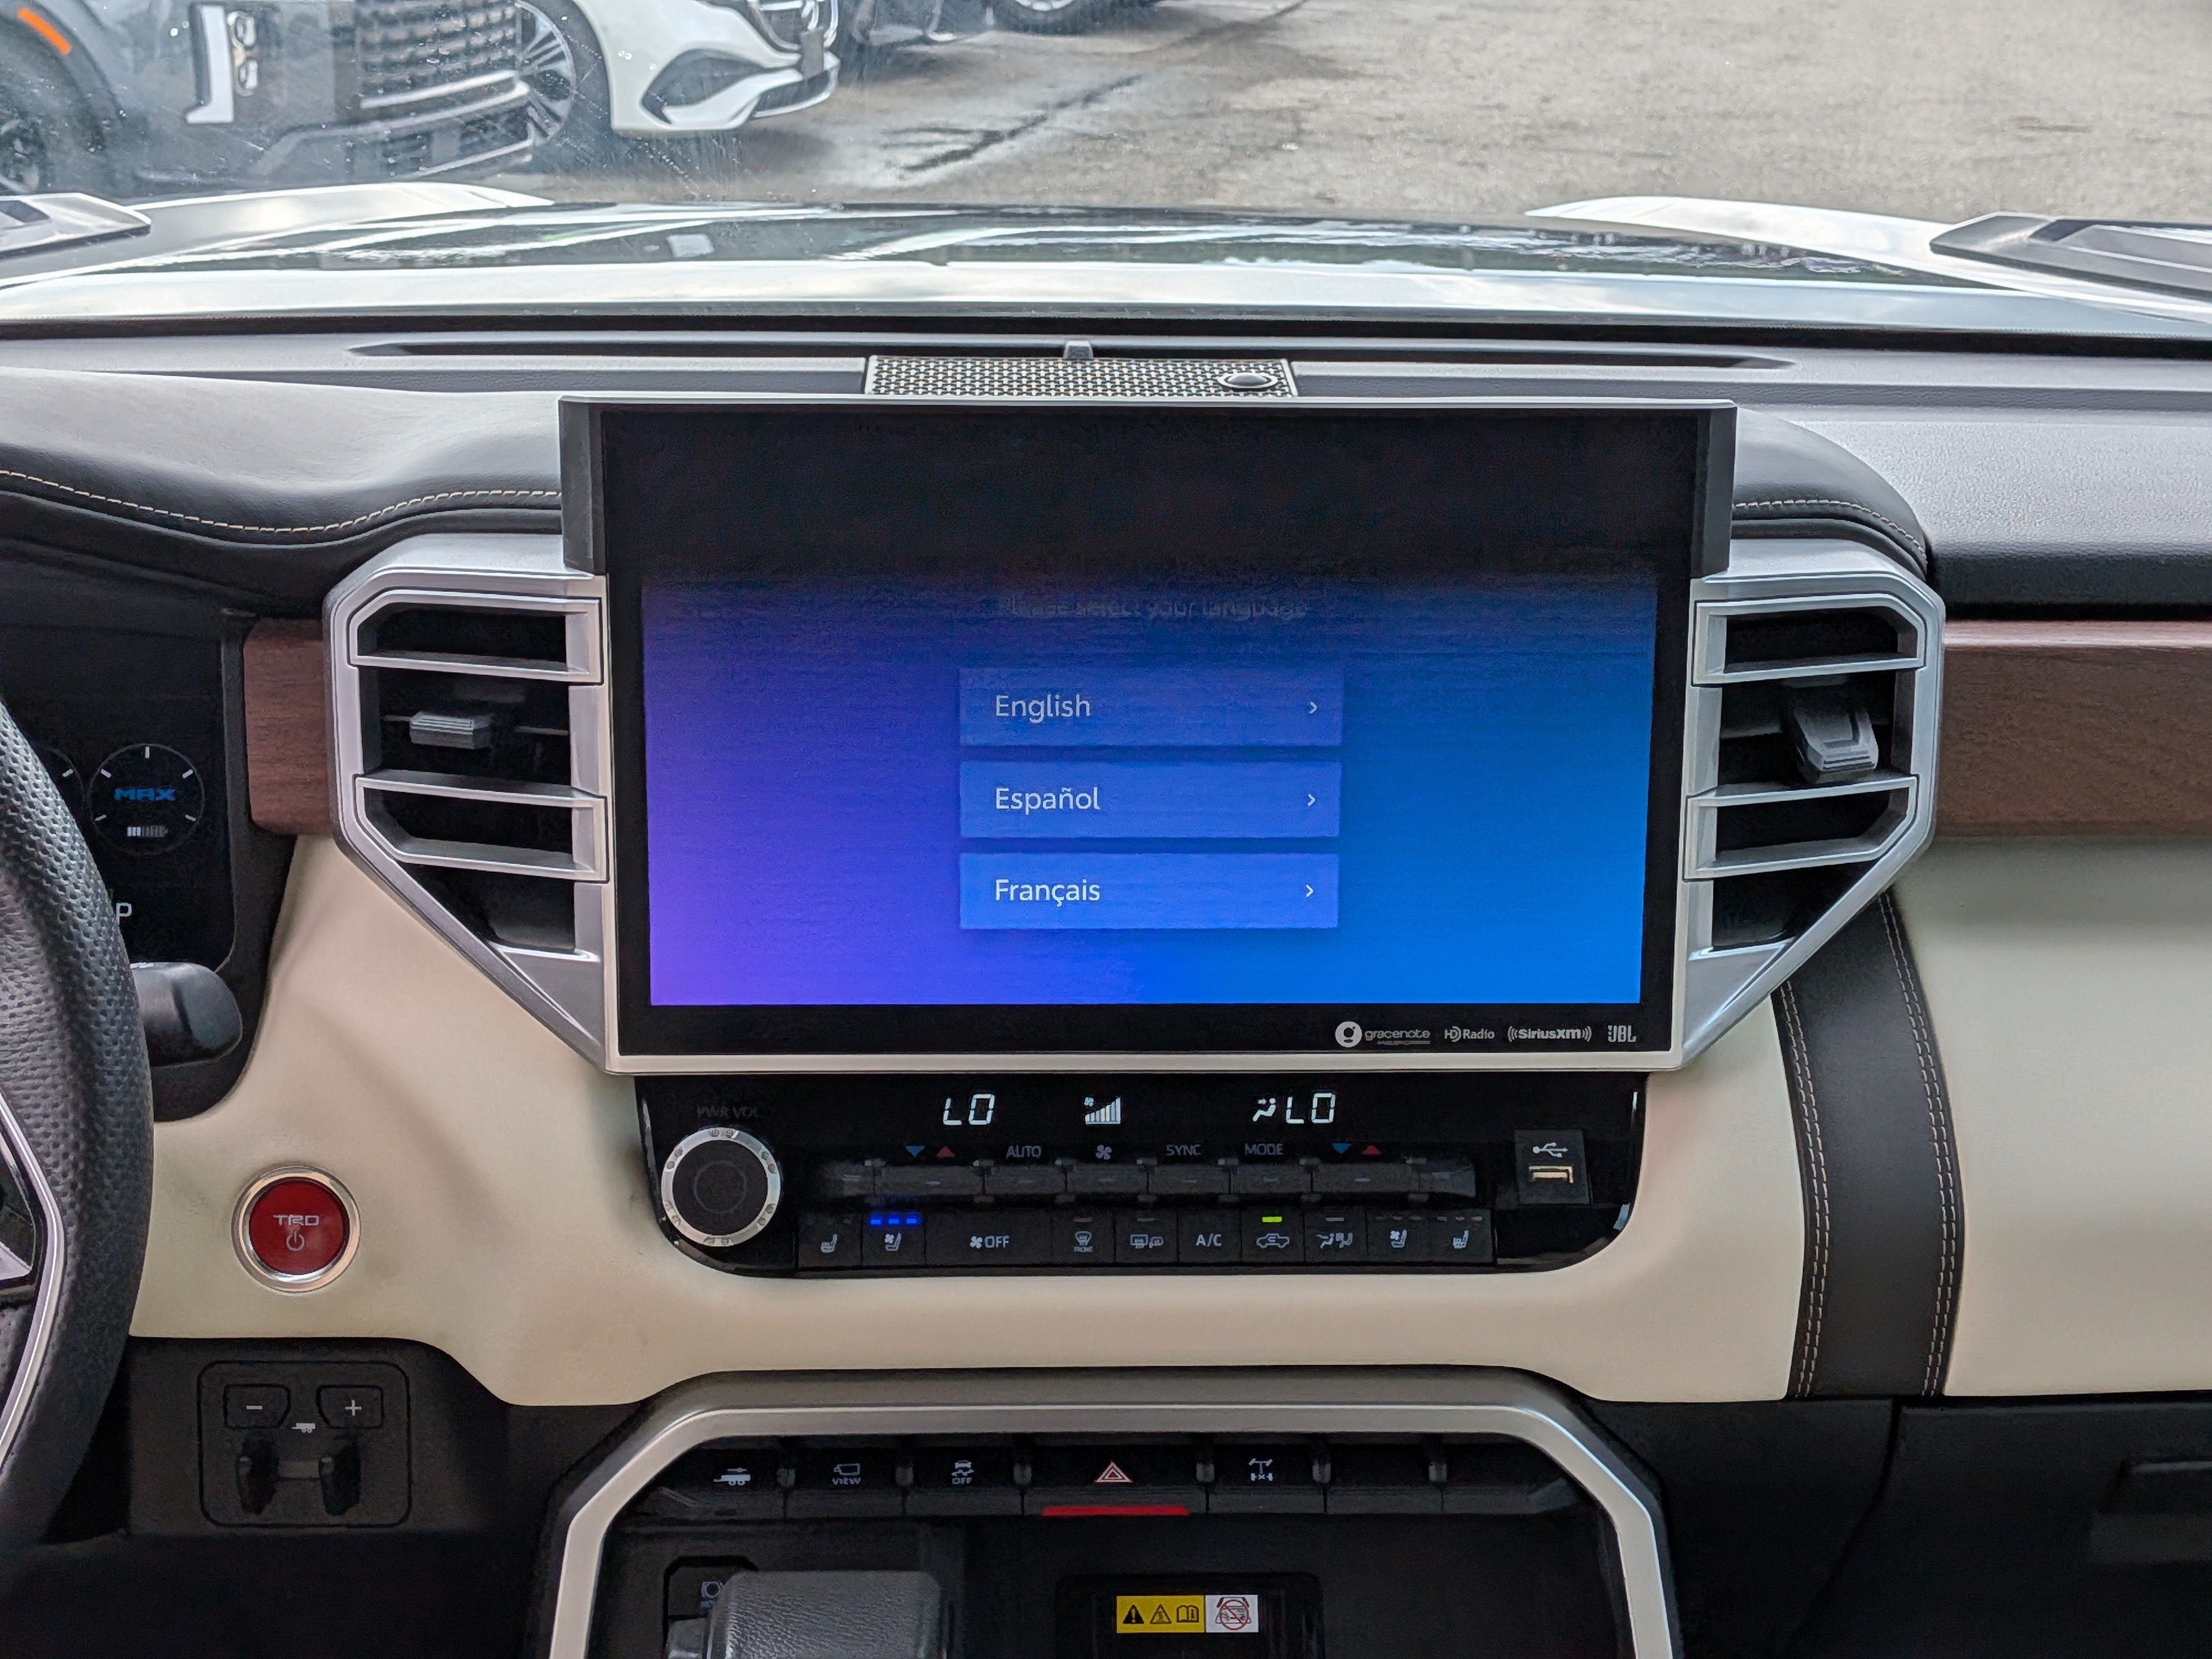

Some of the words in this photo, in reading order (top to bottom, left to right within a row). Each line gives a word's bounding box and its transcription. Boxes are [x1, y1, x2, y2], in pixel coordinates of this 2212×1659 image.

[995, 693, 1091, 723] English
[114, 788, 176, 801] MAX
[995, 786, 1100, 816] Español
[995, 879, 1100, 907] Français
[116, 902, 132, 926] P
[1364, 1028, 1431, 1041] gracenote
[1444, 1026, 1460, 1041] HD
[1463, 1028, 1495, 1040] Radio
[1608, 1025, 1637, 1042] JBL
[1006, 1145, 1042, 1159] AUTO
[1165, 1144, 1202, 1156] SYNC
[1244, 1143, 1284, 1156] MODE
[273, 1214, 320, 1226] TRD
[984, 1235, 1010, 1249] OFF
[1195, 1233, 1222, 1248] A/C
[832, 1477, 861, 1485] VIEW
